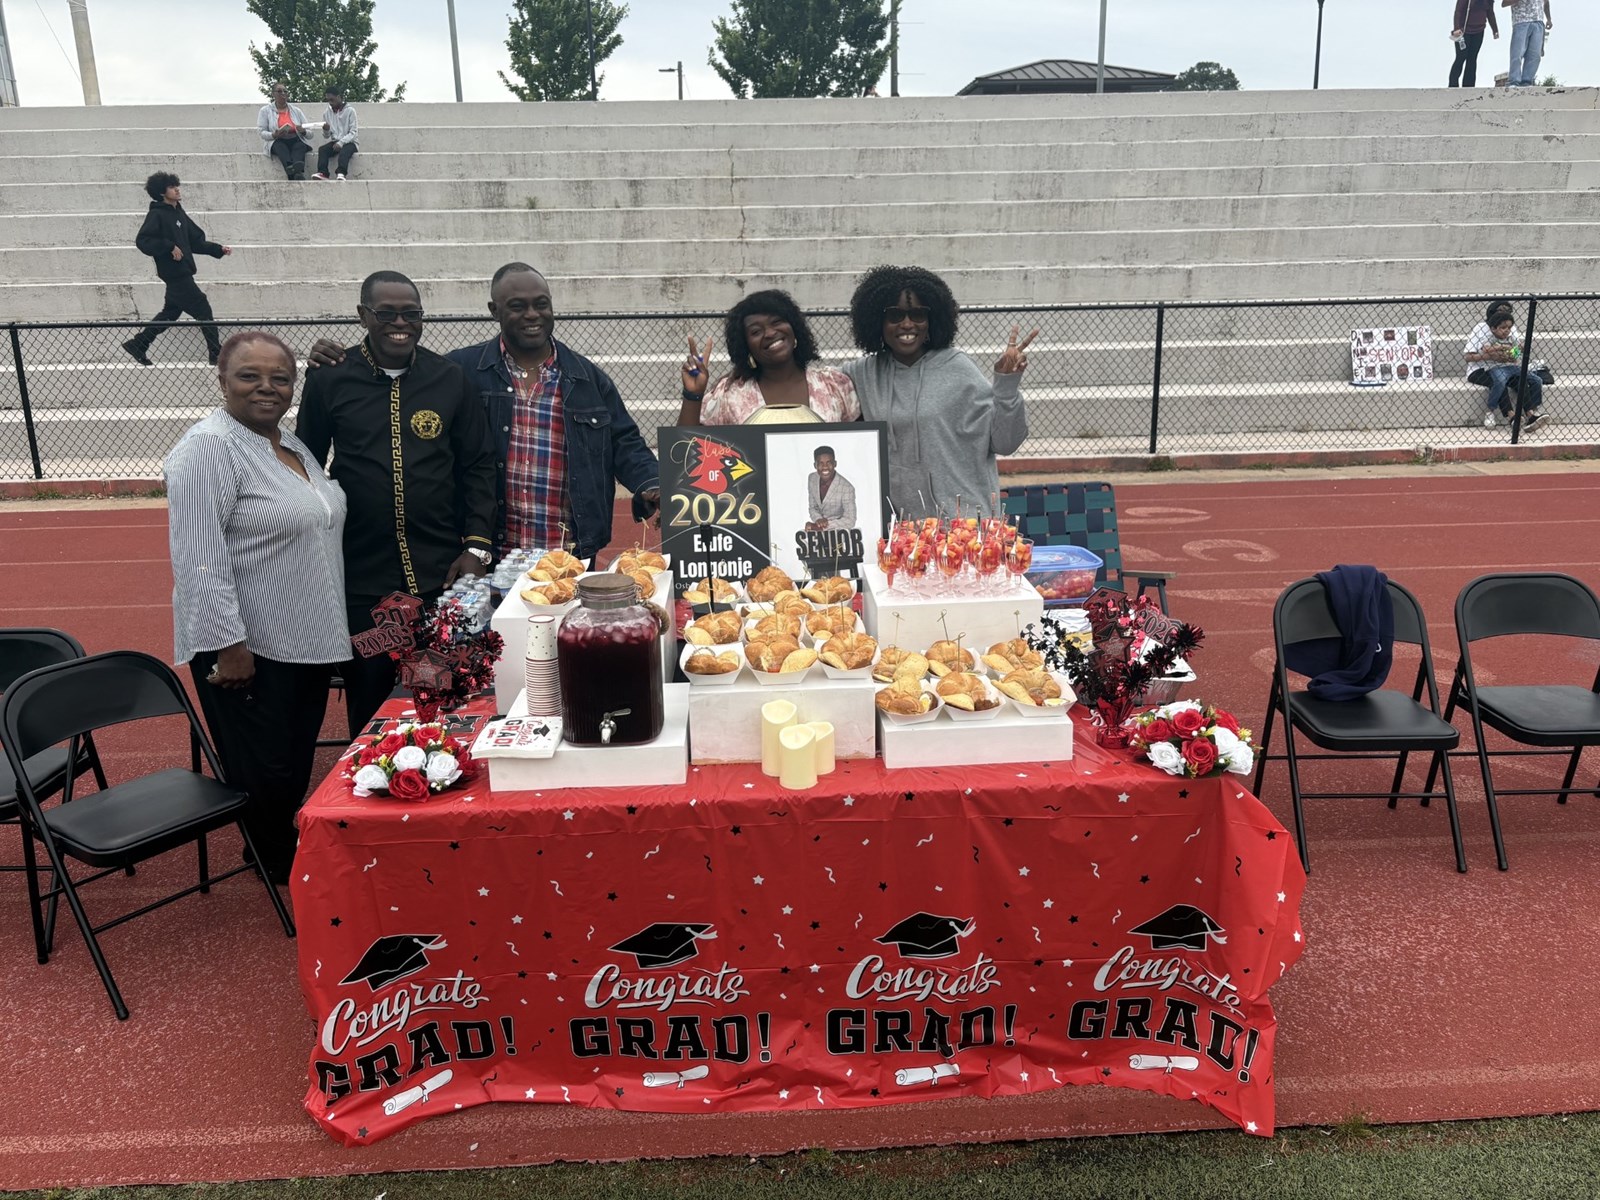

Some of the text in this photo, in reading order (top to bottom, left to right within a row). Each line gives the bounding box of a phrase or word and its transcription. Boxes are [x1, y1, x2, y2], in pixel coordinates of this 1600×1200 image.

[670, 435, 735, 477] Class
[708, 470, 720, 481] OF
[669, 492, 762, 527] 2026
[693, 533, 733, 553] Eufe
[795, 528, 864, 559] SENIOR
[679, 557, 753, 579] Longonje
[355, 625, 403, 656] 2026
[492, 719, 523, 747] GRAD!
[584, 961, 750, 1011] Congrats
[845, 952, 1002, 1003] Congrats
[1093, 945, 1247, 1019] Congrats
[321, 969, 490, 1056] Congrats
[826, 1003, 1018, 1059] GRAD!
[568, 1011, 772, 1065] GRAD!
[1066, 996, 1260, 1083] GRAD!
[315, 1016, 518, 1108] GRAD!
